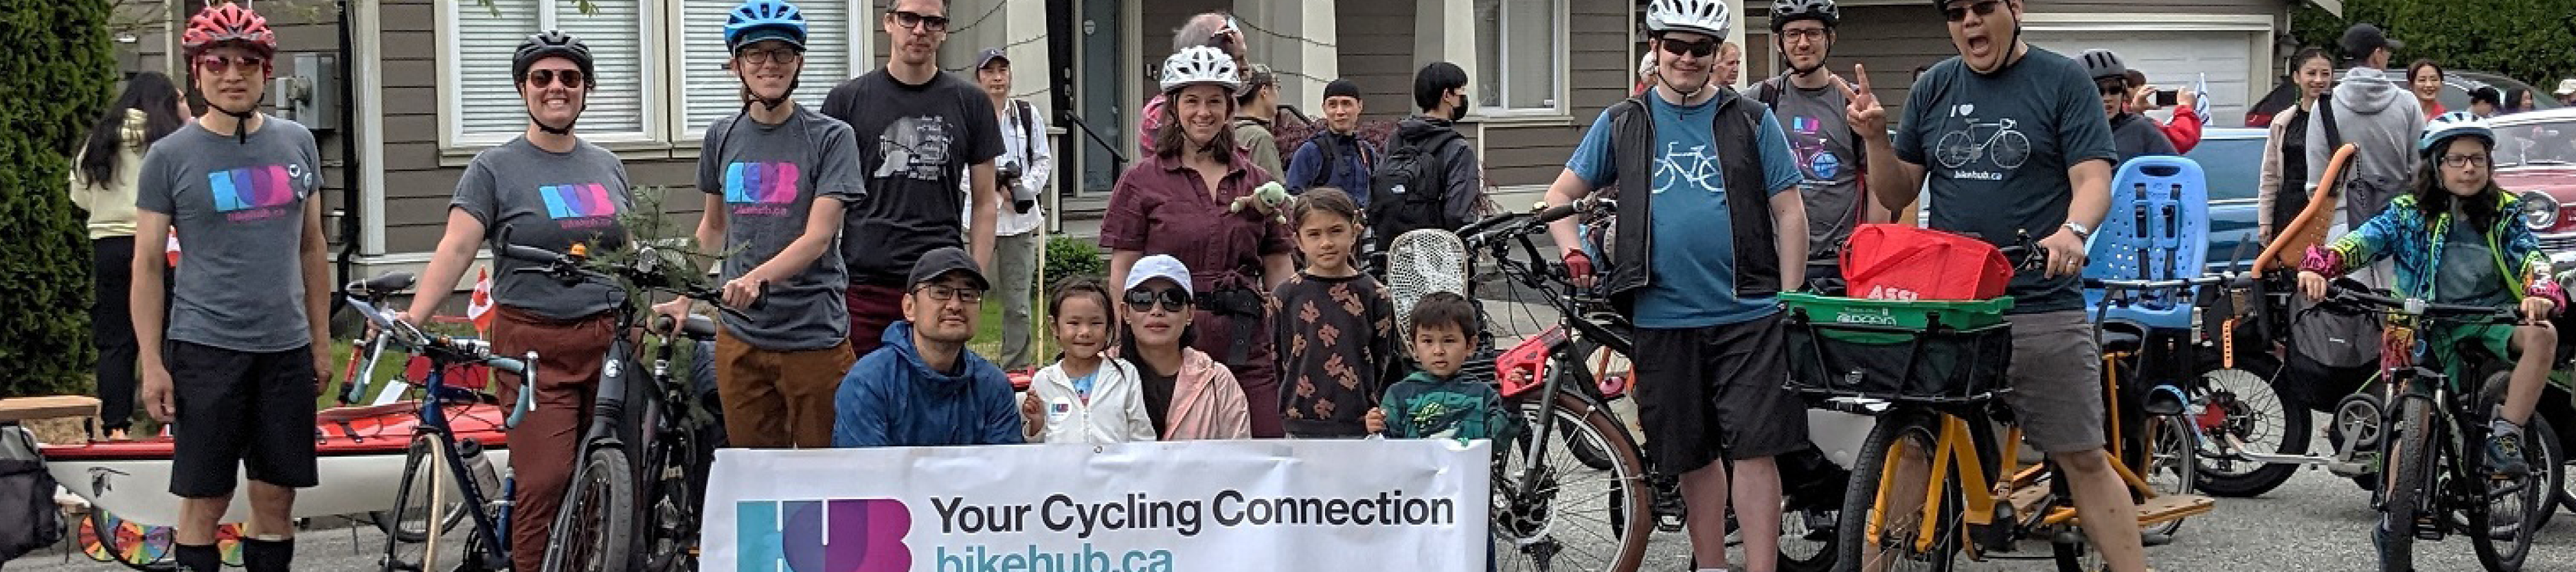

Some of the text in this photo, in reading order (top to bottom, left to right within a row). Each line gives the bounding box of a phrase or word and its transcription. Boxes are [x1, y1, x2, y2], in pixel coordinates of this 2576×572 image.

[1951, 104, 1956, 117] I
[1954, 170, 2002, 180] bikehub.ca
[930, 489, 1454, 538] Your Cycling Connection
[736, 499, 912, 572] HUB
